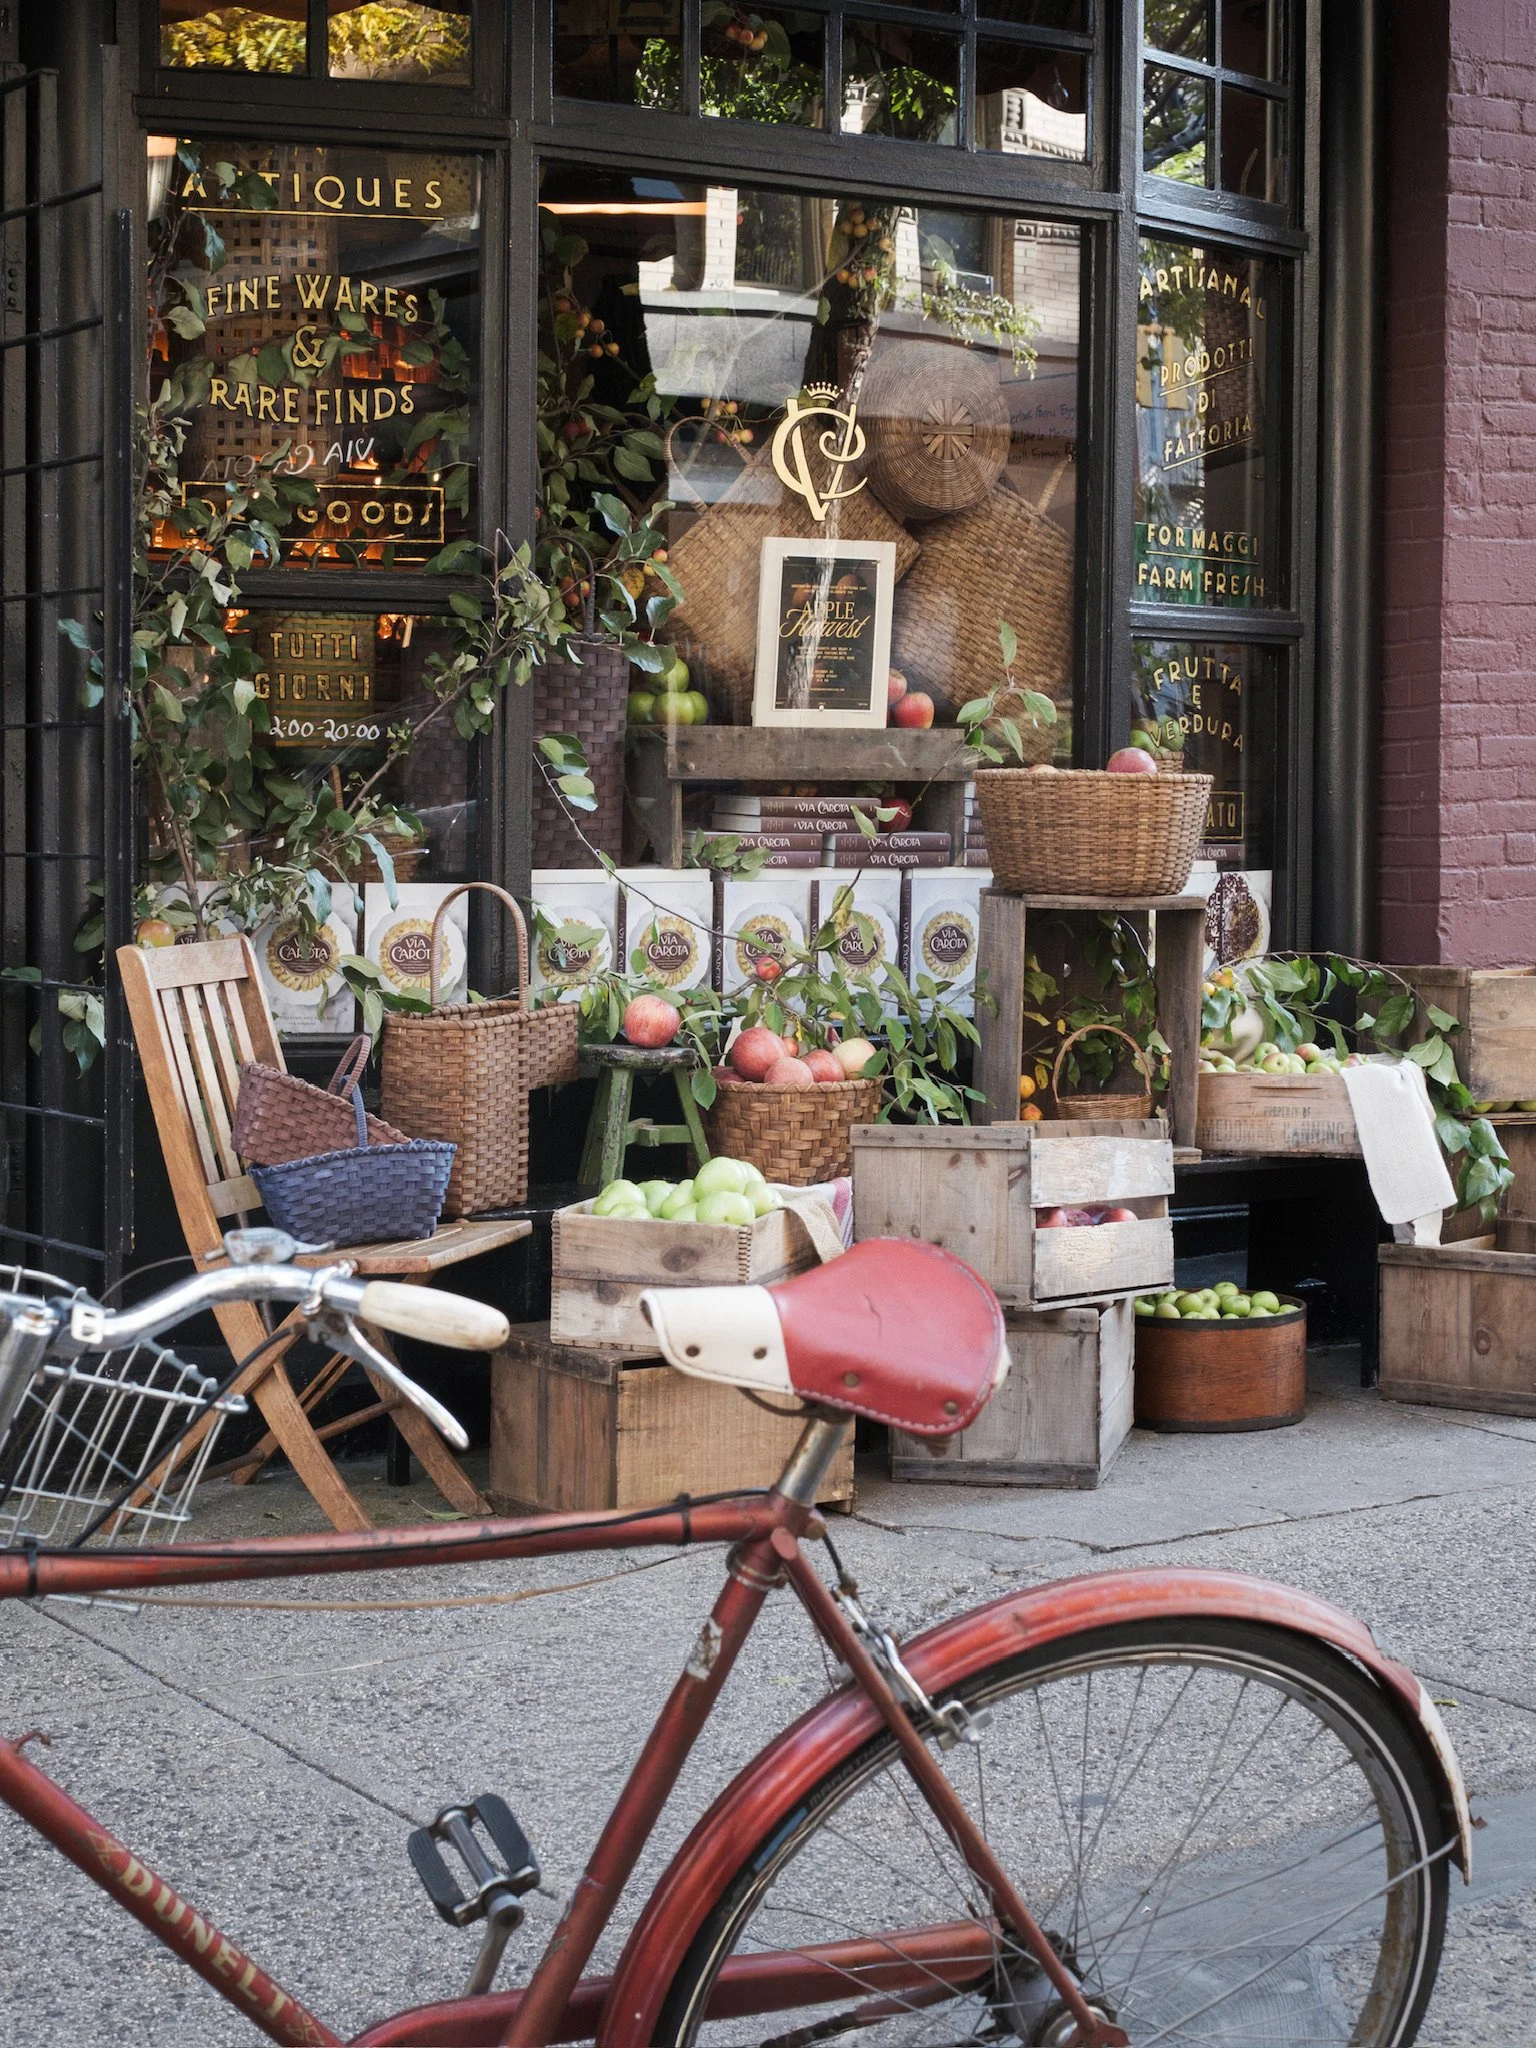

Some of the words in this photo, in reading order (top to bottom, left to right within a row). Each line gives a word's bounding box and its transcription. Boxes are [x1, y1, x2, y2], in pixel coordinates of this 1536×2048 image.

[182, 170, 442, 209] ATIQUES
[207, 275, 281, 317] FINE
[295, 273, 419, 323] WARES
[1139, 265, 1265, 319] ARTISANAL
[292, 325, 327, 368] &
[1160, 337, 1254, 387] PRODOTTI
[210, 378, 301, 424] RARE
[314, 384, 415, 426] FINDS
[1198, 388, 1216, 414] DI
[1164, 413, 1253, 463] FATTORIA
[1146, 522, 1259, 556] FORMAGGI
[1137, 562, 1194, 591] FARM
[1204, 570, 1266, 598] FRESH
[270, 631, 358, 660] TUTTI
[254, 671, 371, 701] GIORNI
[1152, 655, 1242, 696] FRUTTA
[1191, 684, 1201, 705] E
[1150, 713, 1244, 753] VERDURA
[798, 801, 816, 813] VIA
[817, 800, 850, 815] CAROTA
[797, 819, 815, 831] VIA
[815, 818, 848, 833] CAROTA
[757, 836, 791, 850] CAROTA
[889, 837, 921, 850] CAROTA
[868, 854, 887, 865] VIA
[887, 852, 920, 867] CAROTA
[391, 945, 432, 963] CAROT
[648, 943, 690, 960] CAROTA
[930, 936, 968, 952] CAROTA
[118, 1855, 294, 2019] DUNELT
